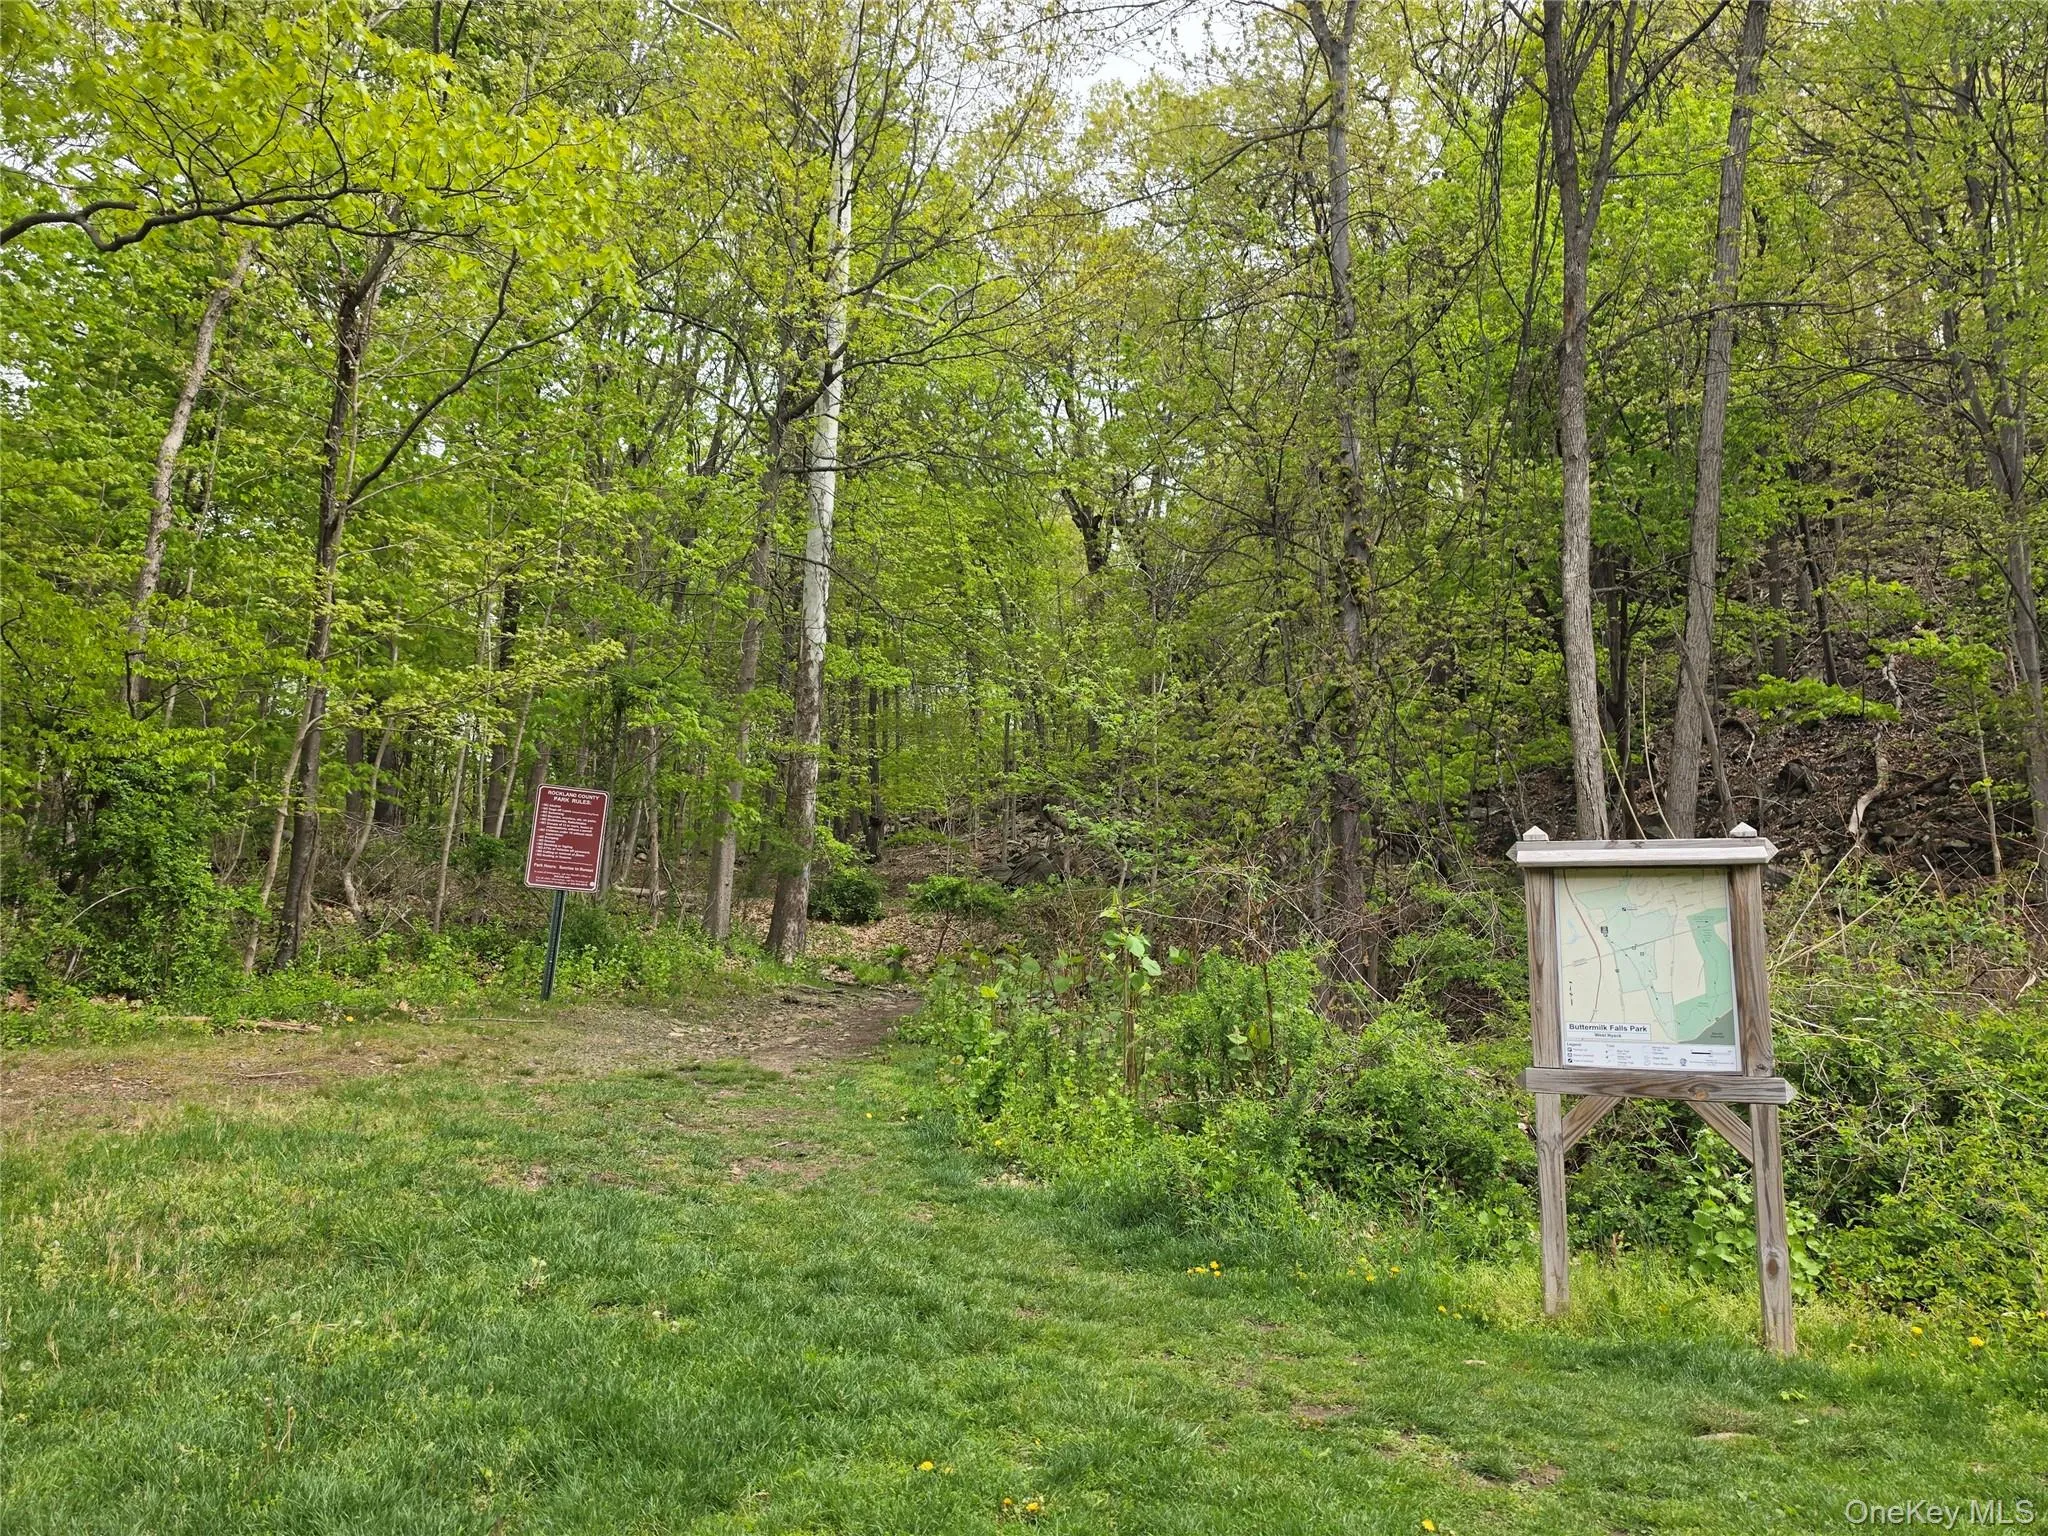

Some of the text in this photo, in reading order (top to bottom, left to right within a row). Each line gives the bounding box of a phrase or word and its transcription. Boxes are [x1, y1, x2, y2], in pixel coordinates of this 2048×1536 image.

[548, 790, 577, 798] ROCKLAND
[1569, 1023, 1608, 1031] Buttermilk
[1610, 1024, 1628, 1032] Falls
